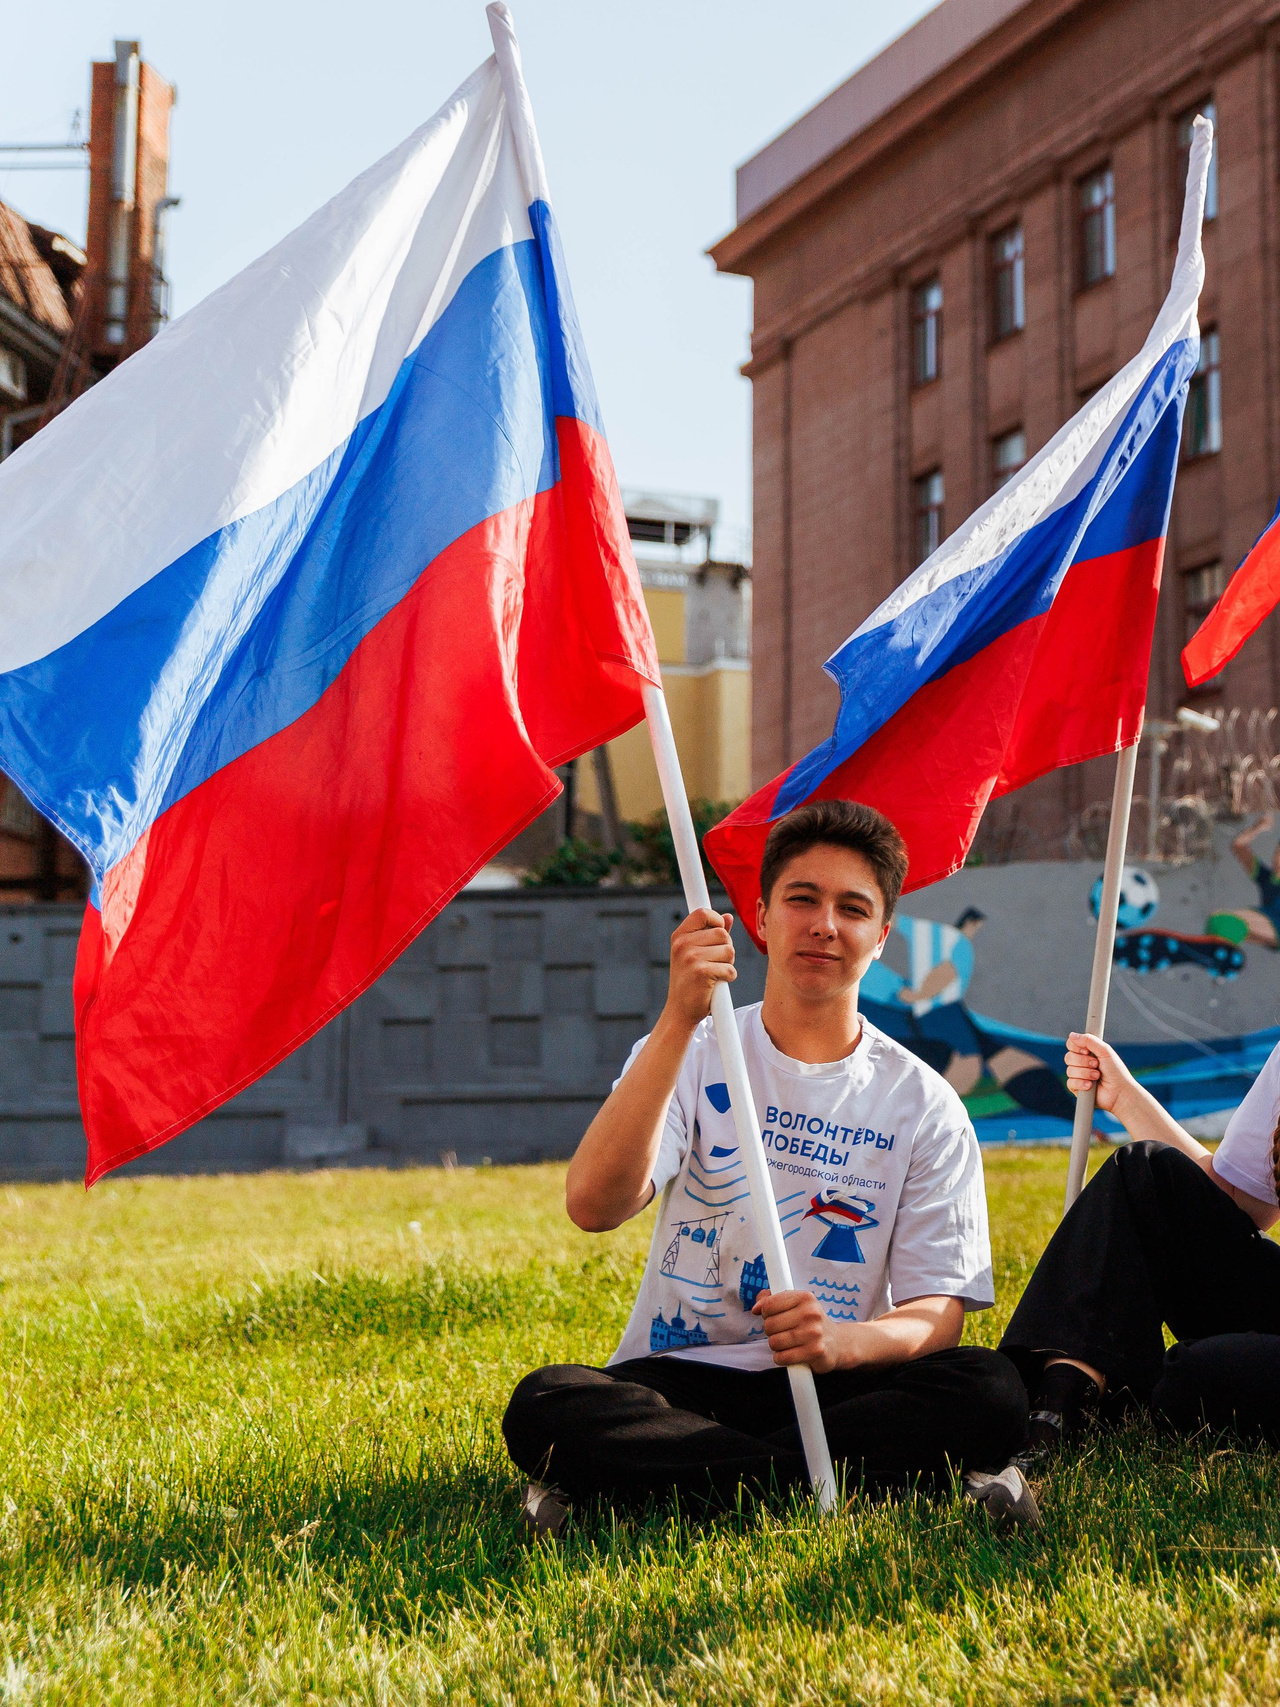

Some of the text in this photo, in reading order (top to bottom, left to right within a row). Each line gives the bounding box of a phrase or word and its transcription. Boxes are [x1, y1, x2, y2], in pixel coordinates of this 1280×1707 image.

[766, 1105, 896, 1151] ВОЛОНТЁРЫ
[762, 1129, 850, 1167] ПОБЕДЫ
[766, 1157, 887, 1191] жегородской области
